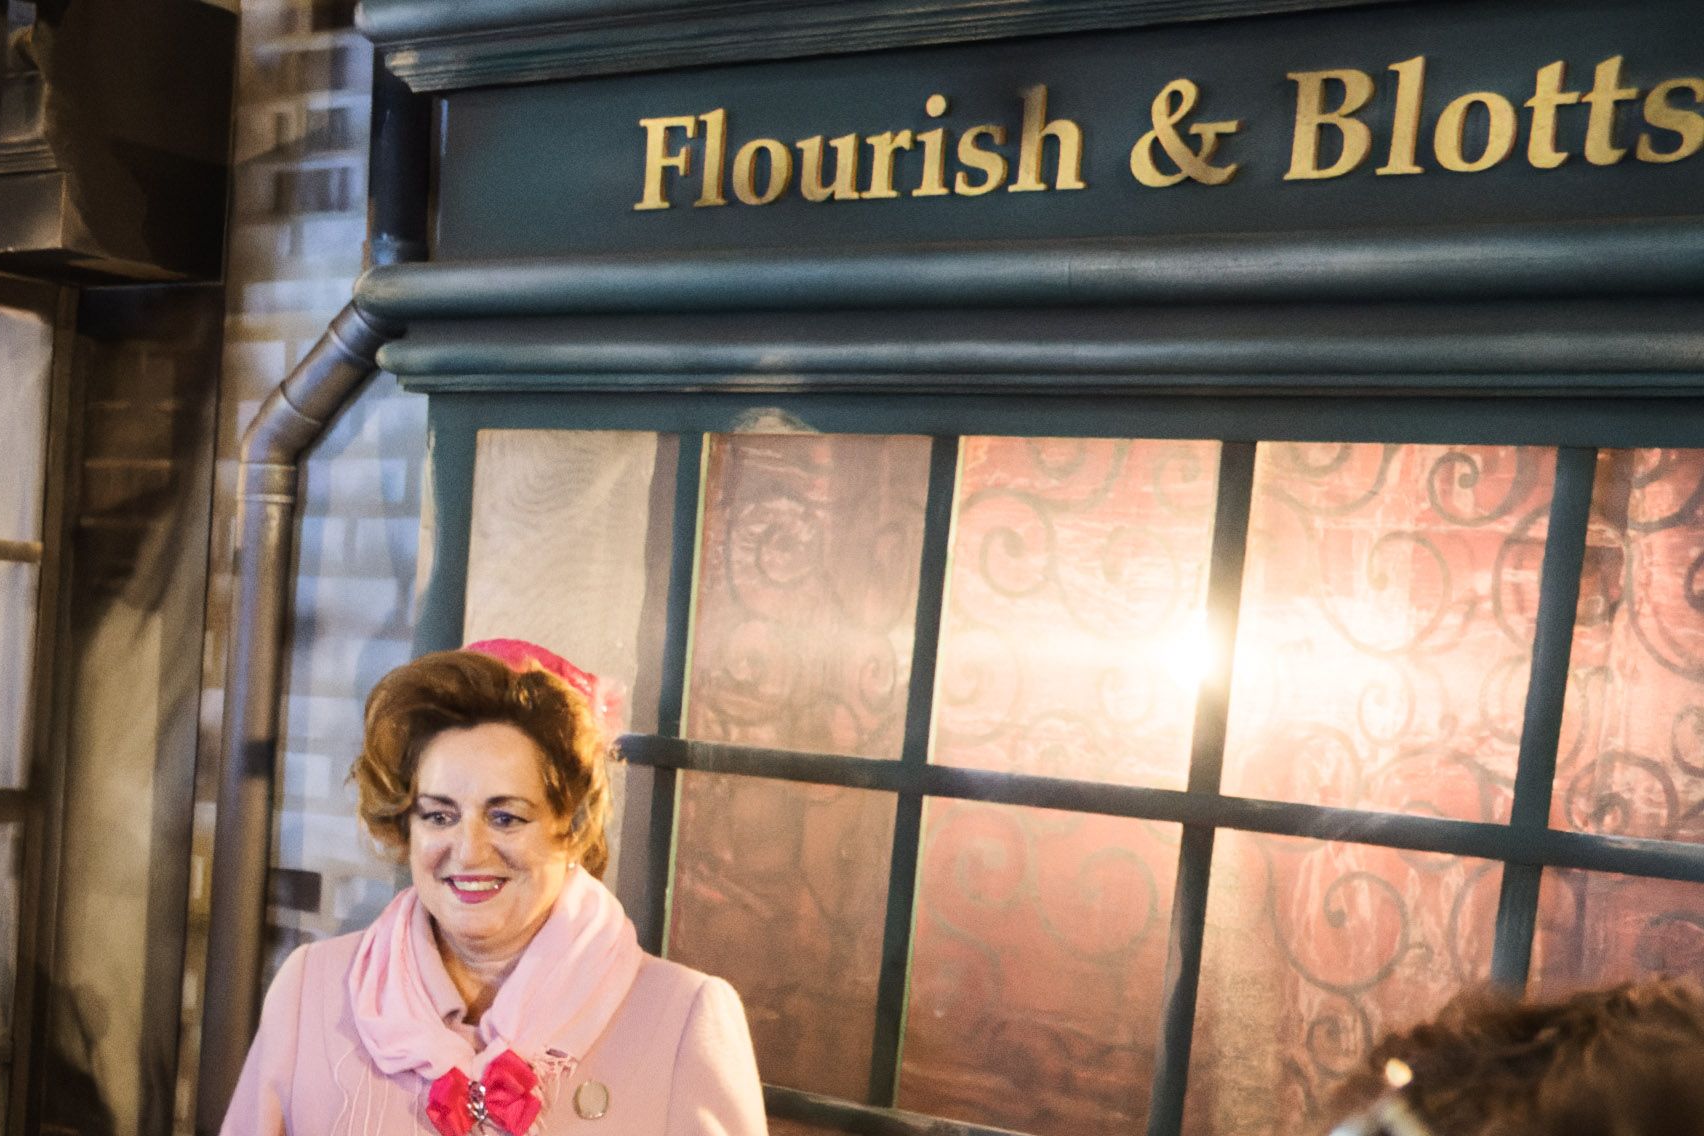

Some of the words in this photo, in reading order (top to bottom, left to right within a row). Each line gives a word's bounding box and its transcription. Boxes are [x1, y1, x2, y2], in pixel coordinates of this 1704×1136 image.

[632, 83, 1089, 211] Flourish
[1129, 77, 1244, 188] &
[1283, 54, 1704, 181] Blotts
